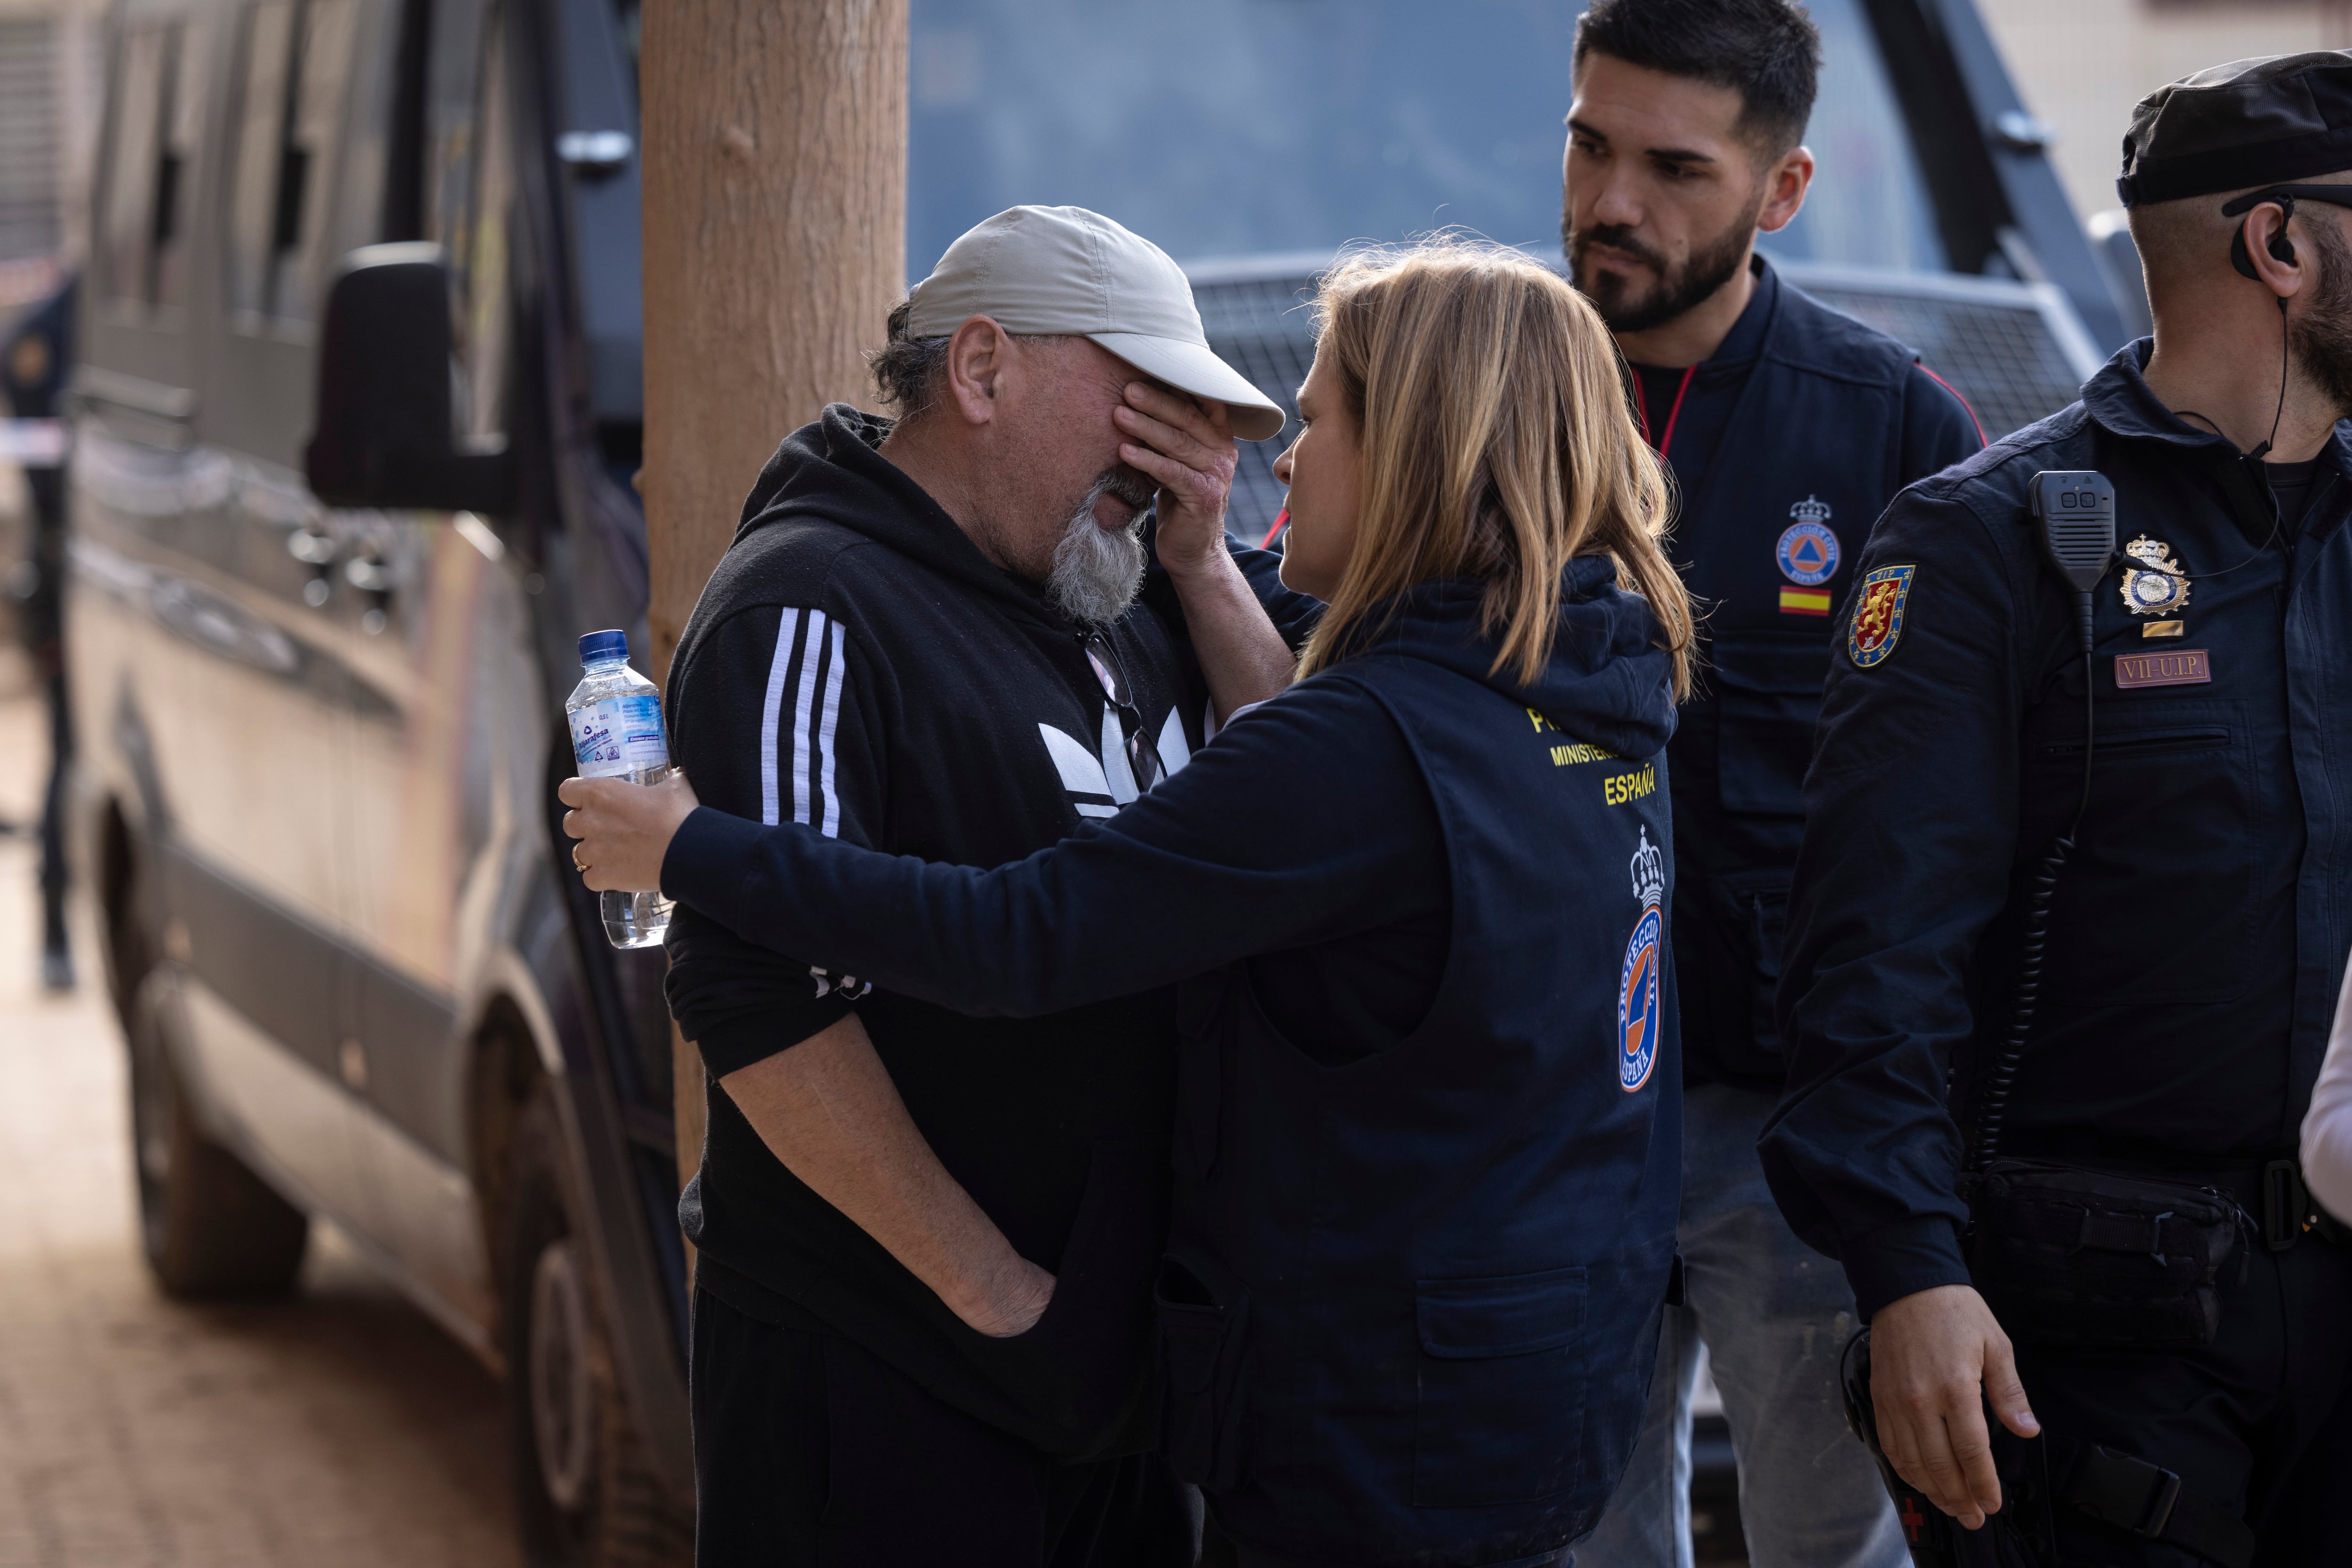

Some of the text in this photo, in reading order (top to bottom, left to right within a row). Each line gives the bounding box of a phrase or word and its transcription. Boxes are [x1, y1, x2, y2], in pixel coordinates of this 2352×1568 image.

[1877, 570, 1894, 579] UIP
[2123, 657, 2201, 679] VII-U.I.P.
[579, 729, 609, 751] Aljarafesa
[1605, 762, 1655, 806] ESPAÑA
[1622, 1047, 1649, 1082] ESPAÑA
